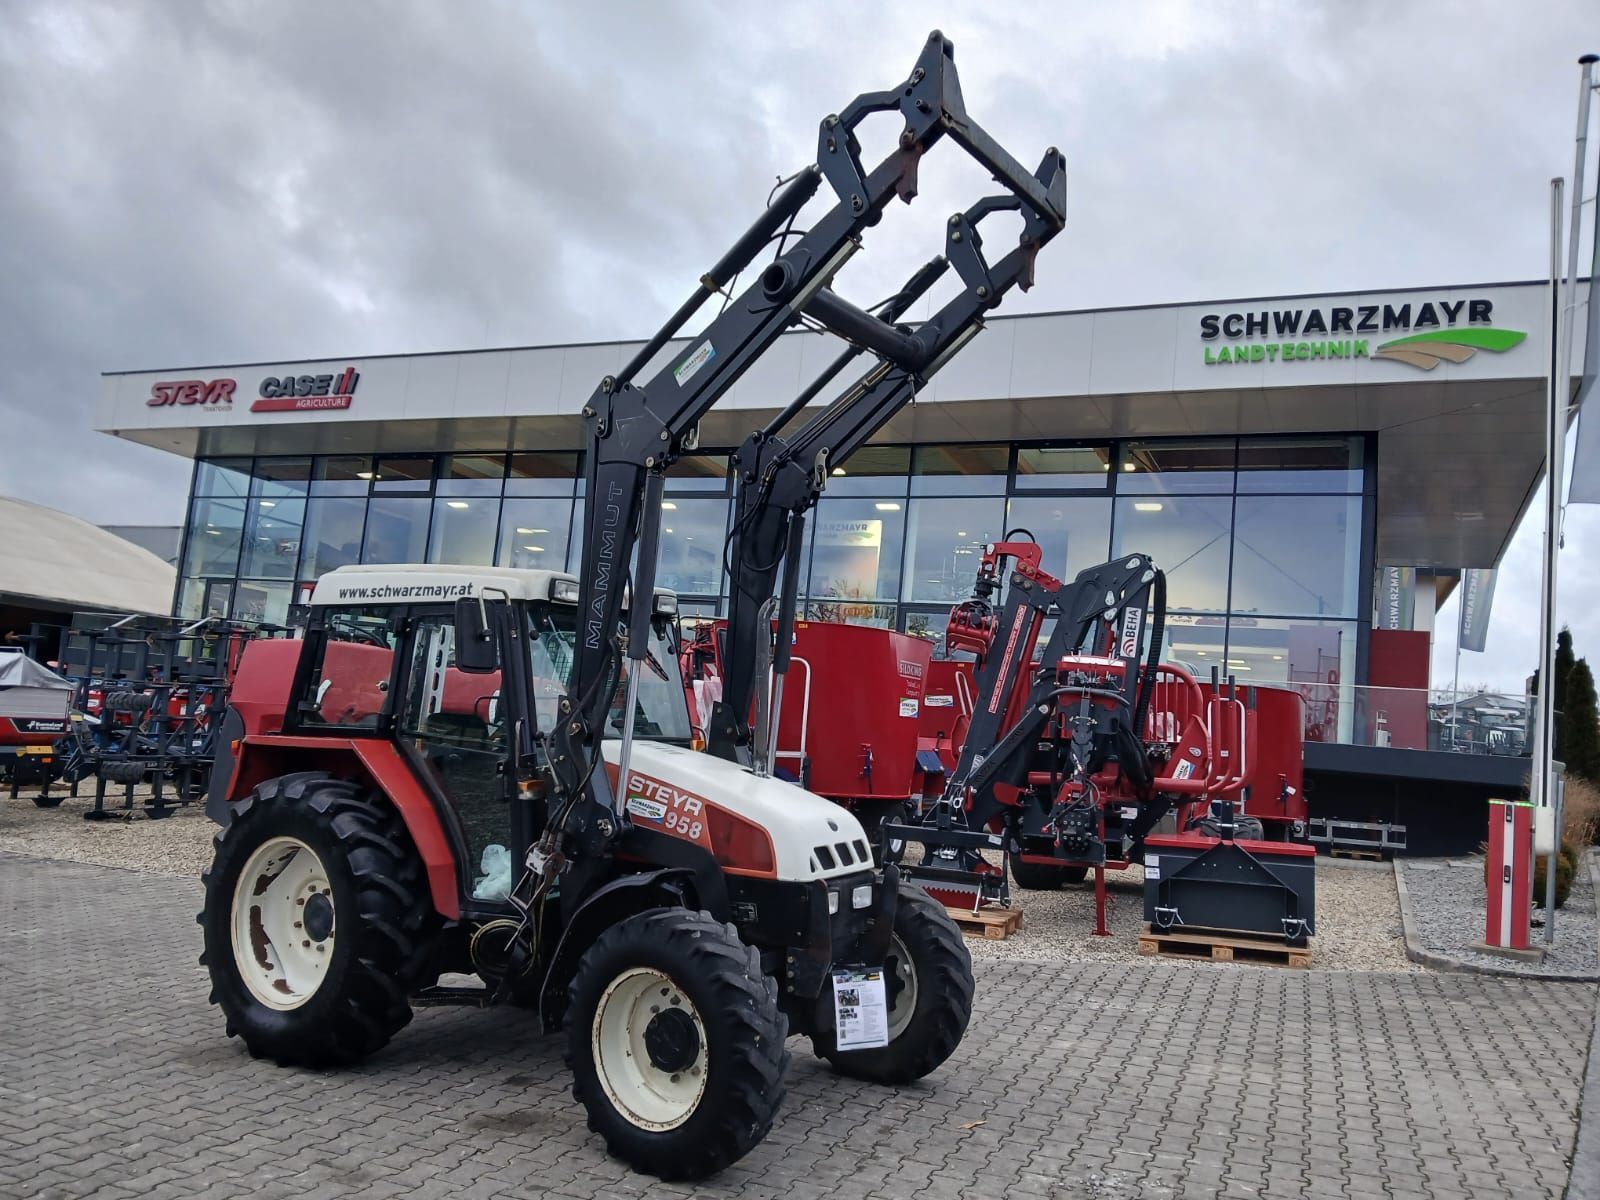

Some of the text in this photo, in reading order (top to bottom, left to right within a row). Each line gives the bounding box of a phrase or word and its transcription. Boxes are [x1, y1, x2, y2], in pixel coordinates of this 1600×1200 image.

[1200, 299, 1493, 340] SCHWARZMAYR
[1204, 339, 1369, 365] LANDTECHNIK
[146, 378, 238, 407] STEYR
[259, 375, 333, 398] CASE
[296, 398, 346, 409] AGRICULTURE
[586, 481, 623, 649] MAMMUT
[339, 582, 473, 599] www.schwarzmayr.at
[1125, 609, 1139, 638] BEHA
[628, 775, 703, 817] STEYR
[665, 811, 703, 839] 958
